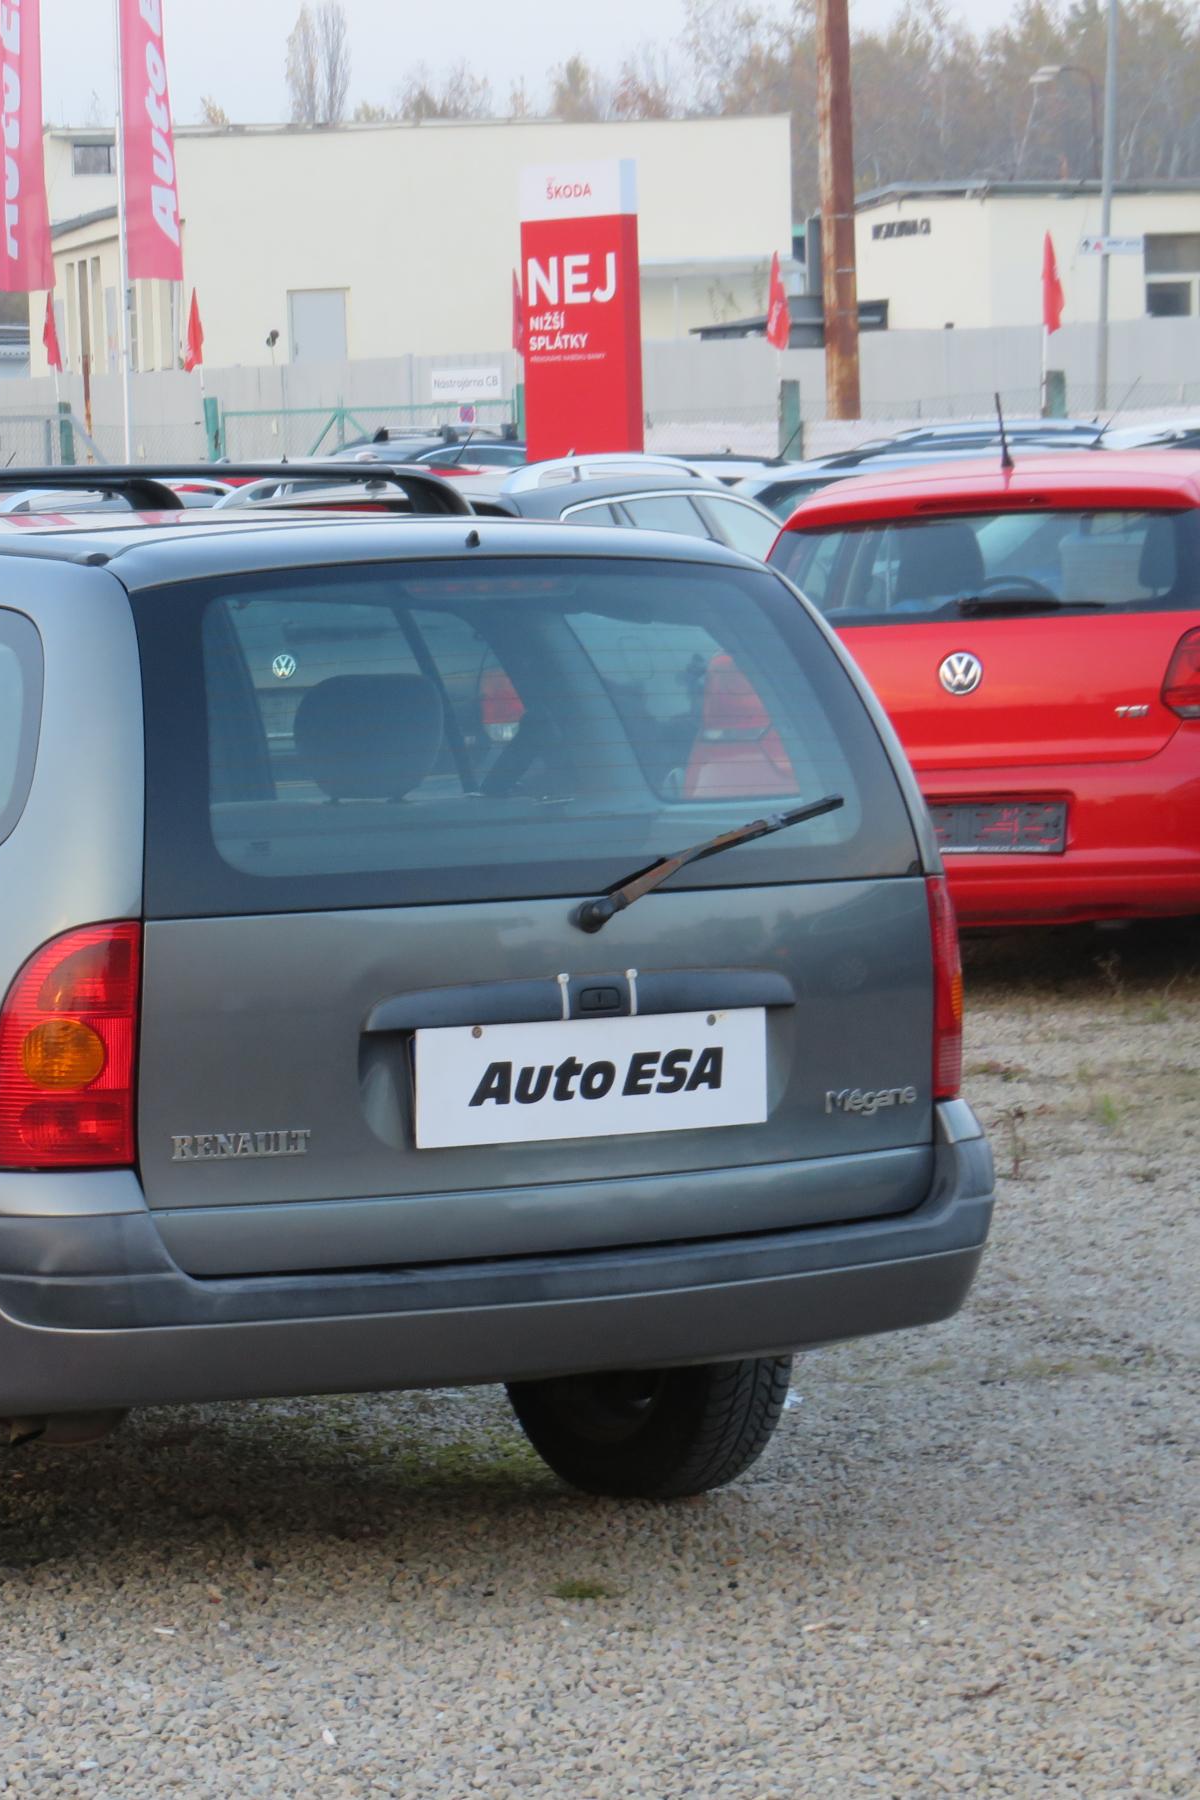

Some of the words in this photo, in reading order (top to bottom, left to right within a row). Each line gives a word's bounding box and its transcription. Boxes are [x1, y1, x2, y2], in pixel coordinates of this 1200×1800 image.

[144, 41, 181, 247] Auto
[546, 182, 593, 200] ŠKODA
[527, 252, 618, 307] NEJ
[529, 311, 565, 332] NIŽŠÍ
[529, 331, 589, 352] SPLÁTKY
[1114, 705, 1149, 718] TSI
[468, 1056, 617, 1107] Auto
[622, 1047, 724, 1096] ESA
[825, 1086, 917, 1116] Mégane
[171, 1130, 311, 1162] RENAULT
